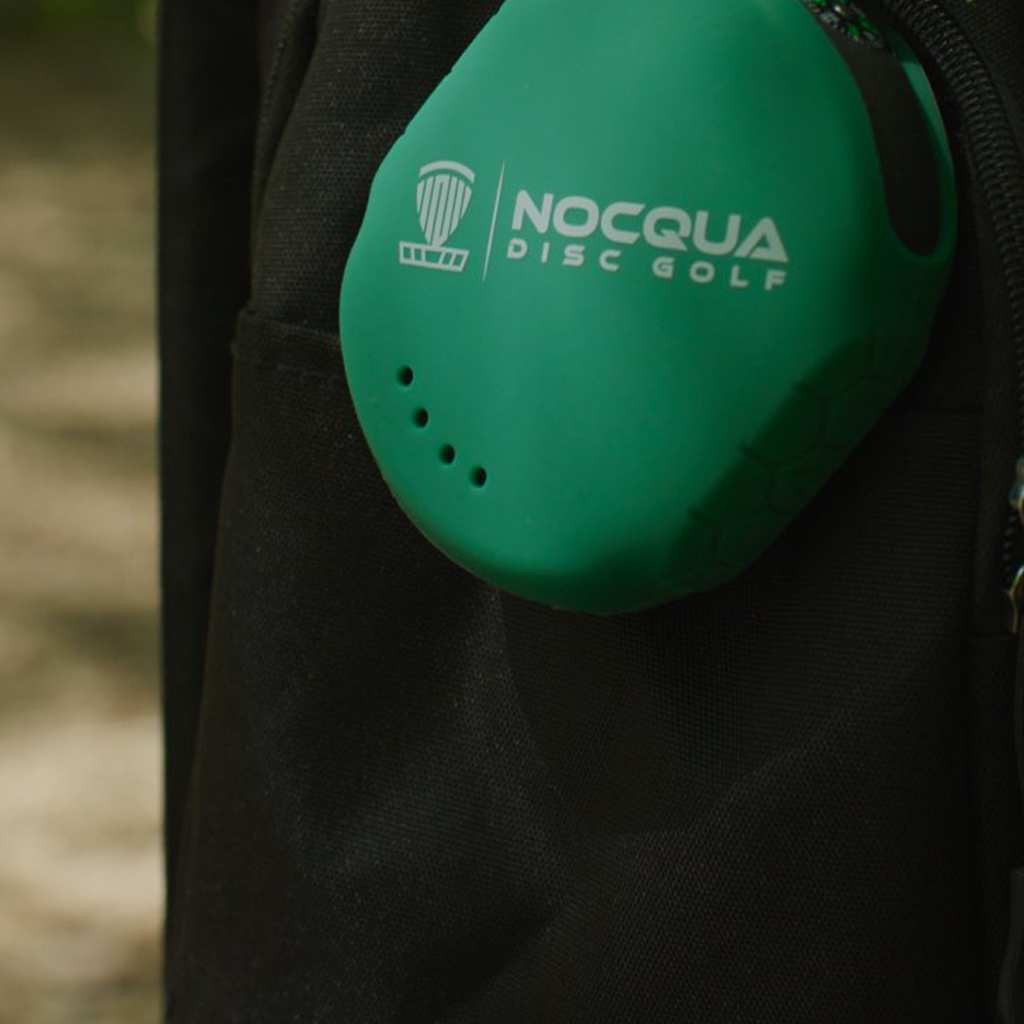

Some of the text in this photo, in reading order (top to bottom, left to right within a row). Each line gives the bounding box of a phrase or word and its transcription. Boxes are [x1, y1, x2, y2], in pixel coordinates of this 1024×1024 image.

[511, 189, 789, 263] NOCQUA
[507, 238, 787, 290] DISC GOLF
